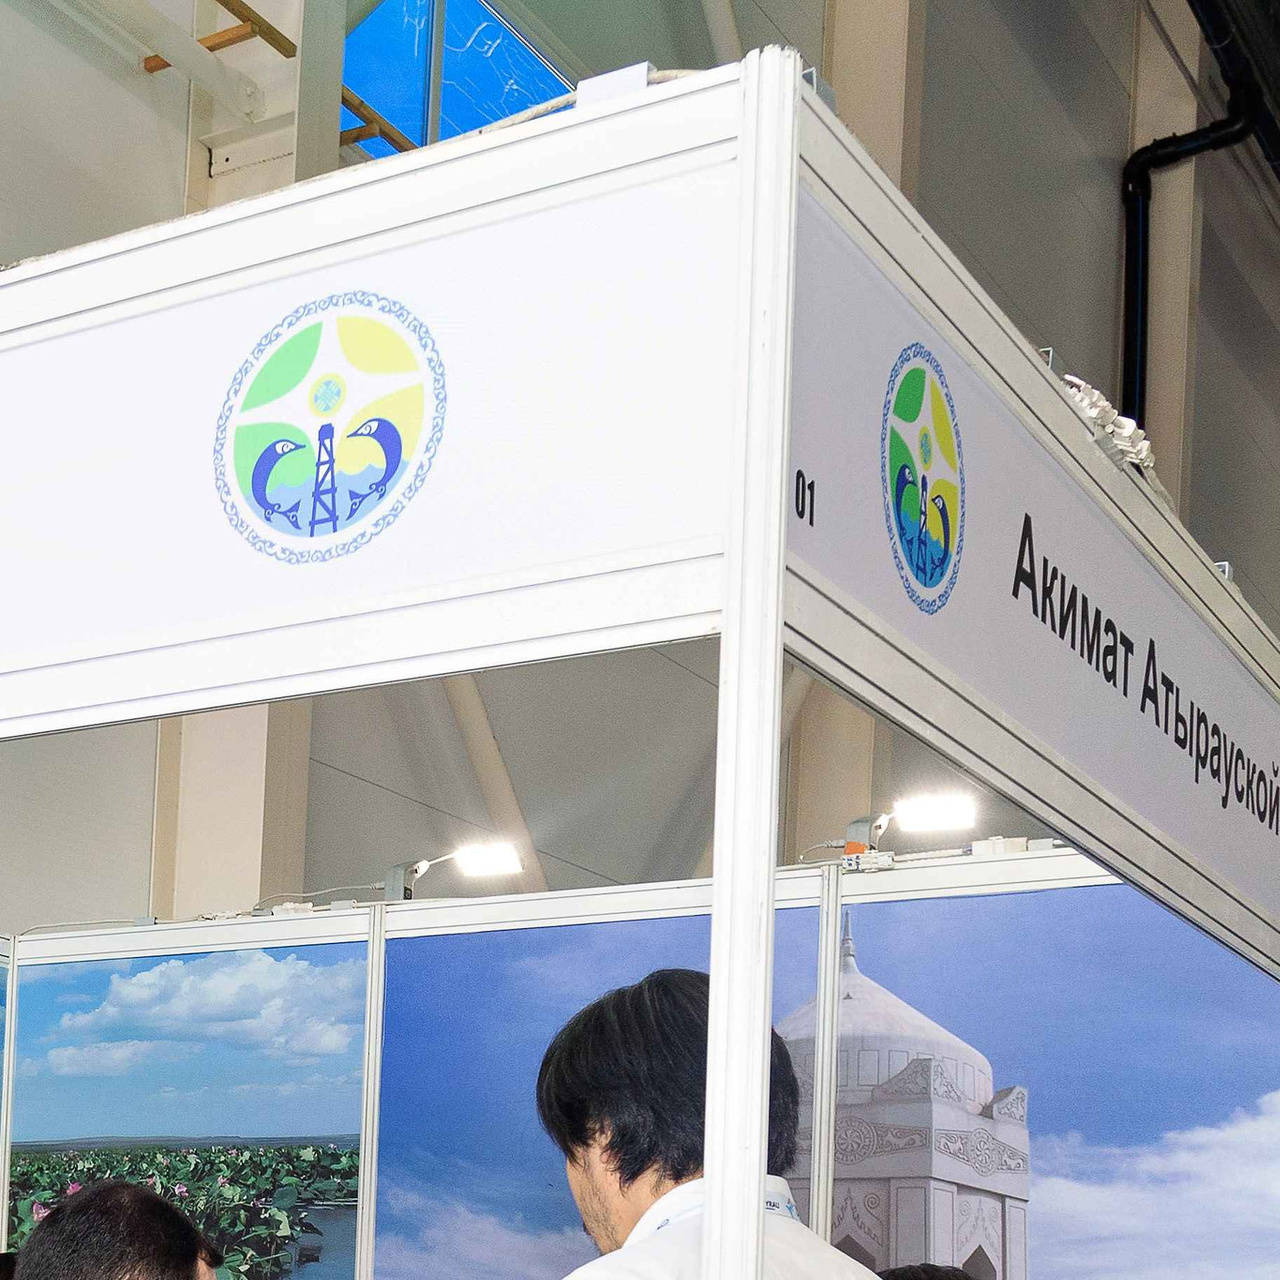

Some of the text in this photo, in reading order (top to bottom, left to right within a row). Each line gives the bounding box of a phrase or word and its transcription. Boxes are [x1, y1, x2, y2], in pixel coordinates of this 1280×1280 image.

[795, 468, 815, 527] 01
[1012, 512, 1280, 836] Акимат Атырауской
